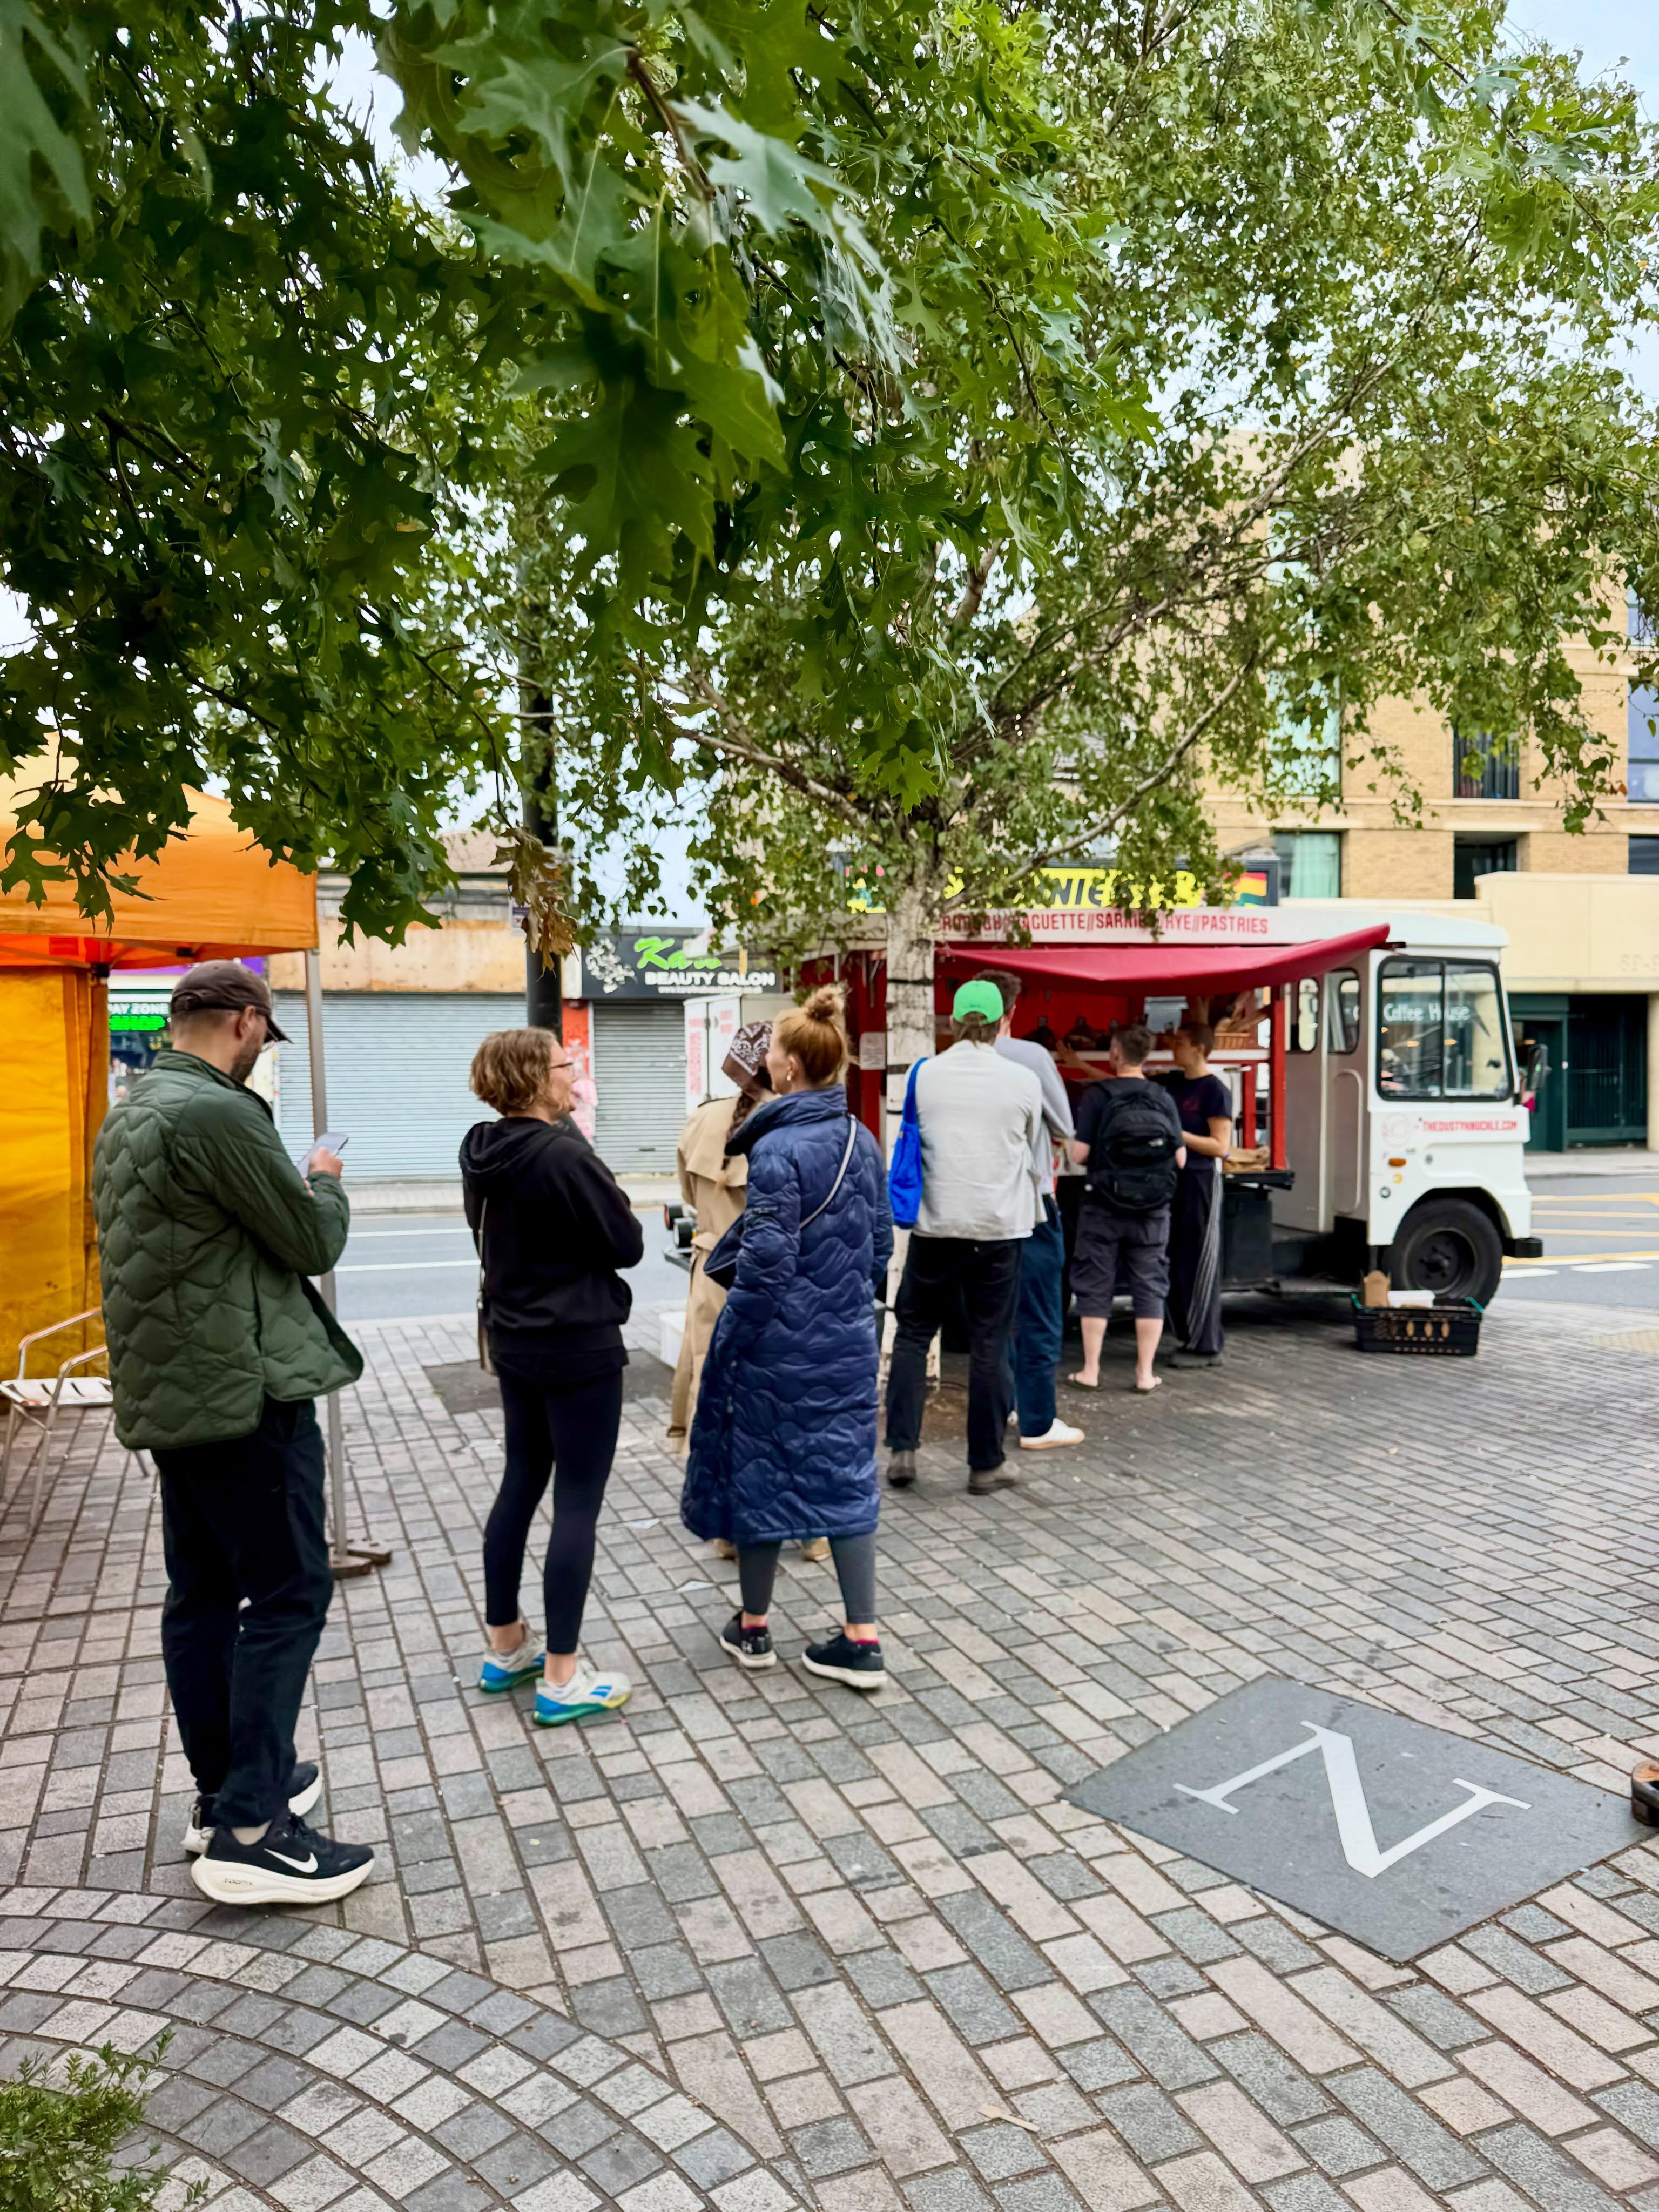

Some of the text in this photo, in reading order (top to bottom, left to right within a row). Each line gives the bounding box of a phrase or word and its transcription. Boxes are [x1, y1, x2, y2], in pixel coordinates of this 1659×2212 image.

[645, 971, 775, 986] BEAUTY SALON
[1172, 1720, 1532, 1879] N
